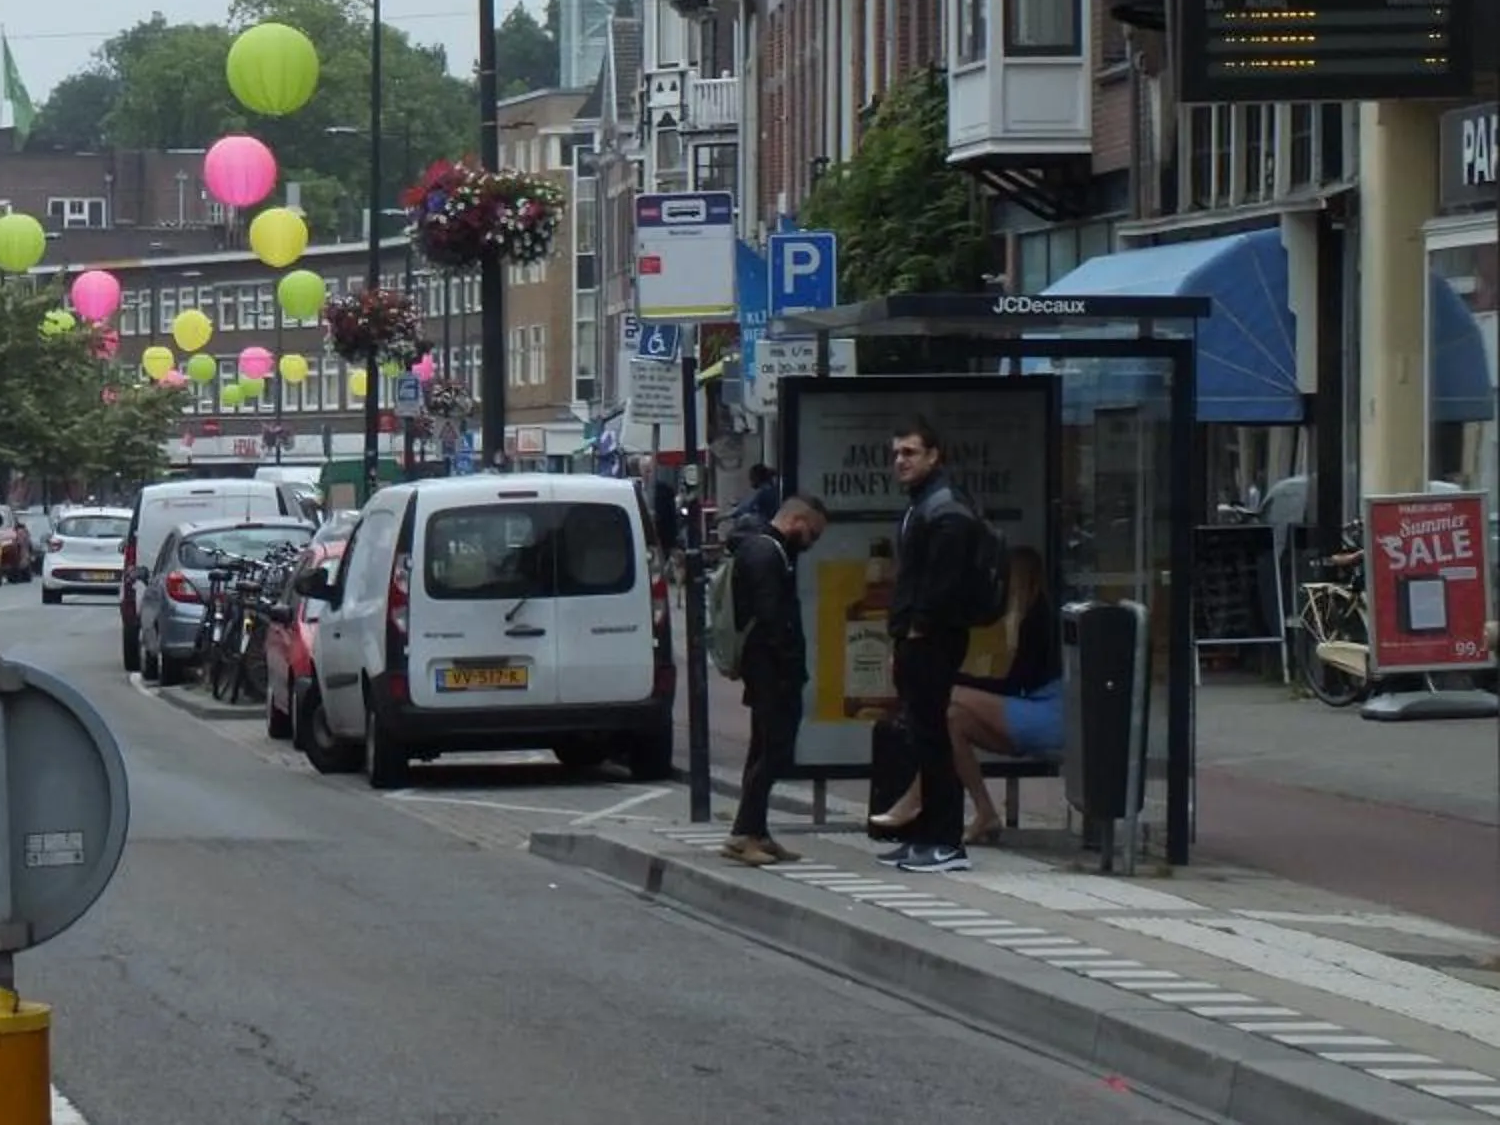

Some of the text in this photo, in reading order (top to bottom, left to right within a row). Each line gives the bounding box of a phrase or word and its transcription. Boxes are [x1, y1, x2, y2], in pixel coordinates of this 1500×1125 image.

[784, 243, 820, 294] P
[992, 295, 1086, 314] JCDecaux
[1400, 514, 1468, 537] Summer
[1377, 529, 1474, 571] SALE
